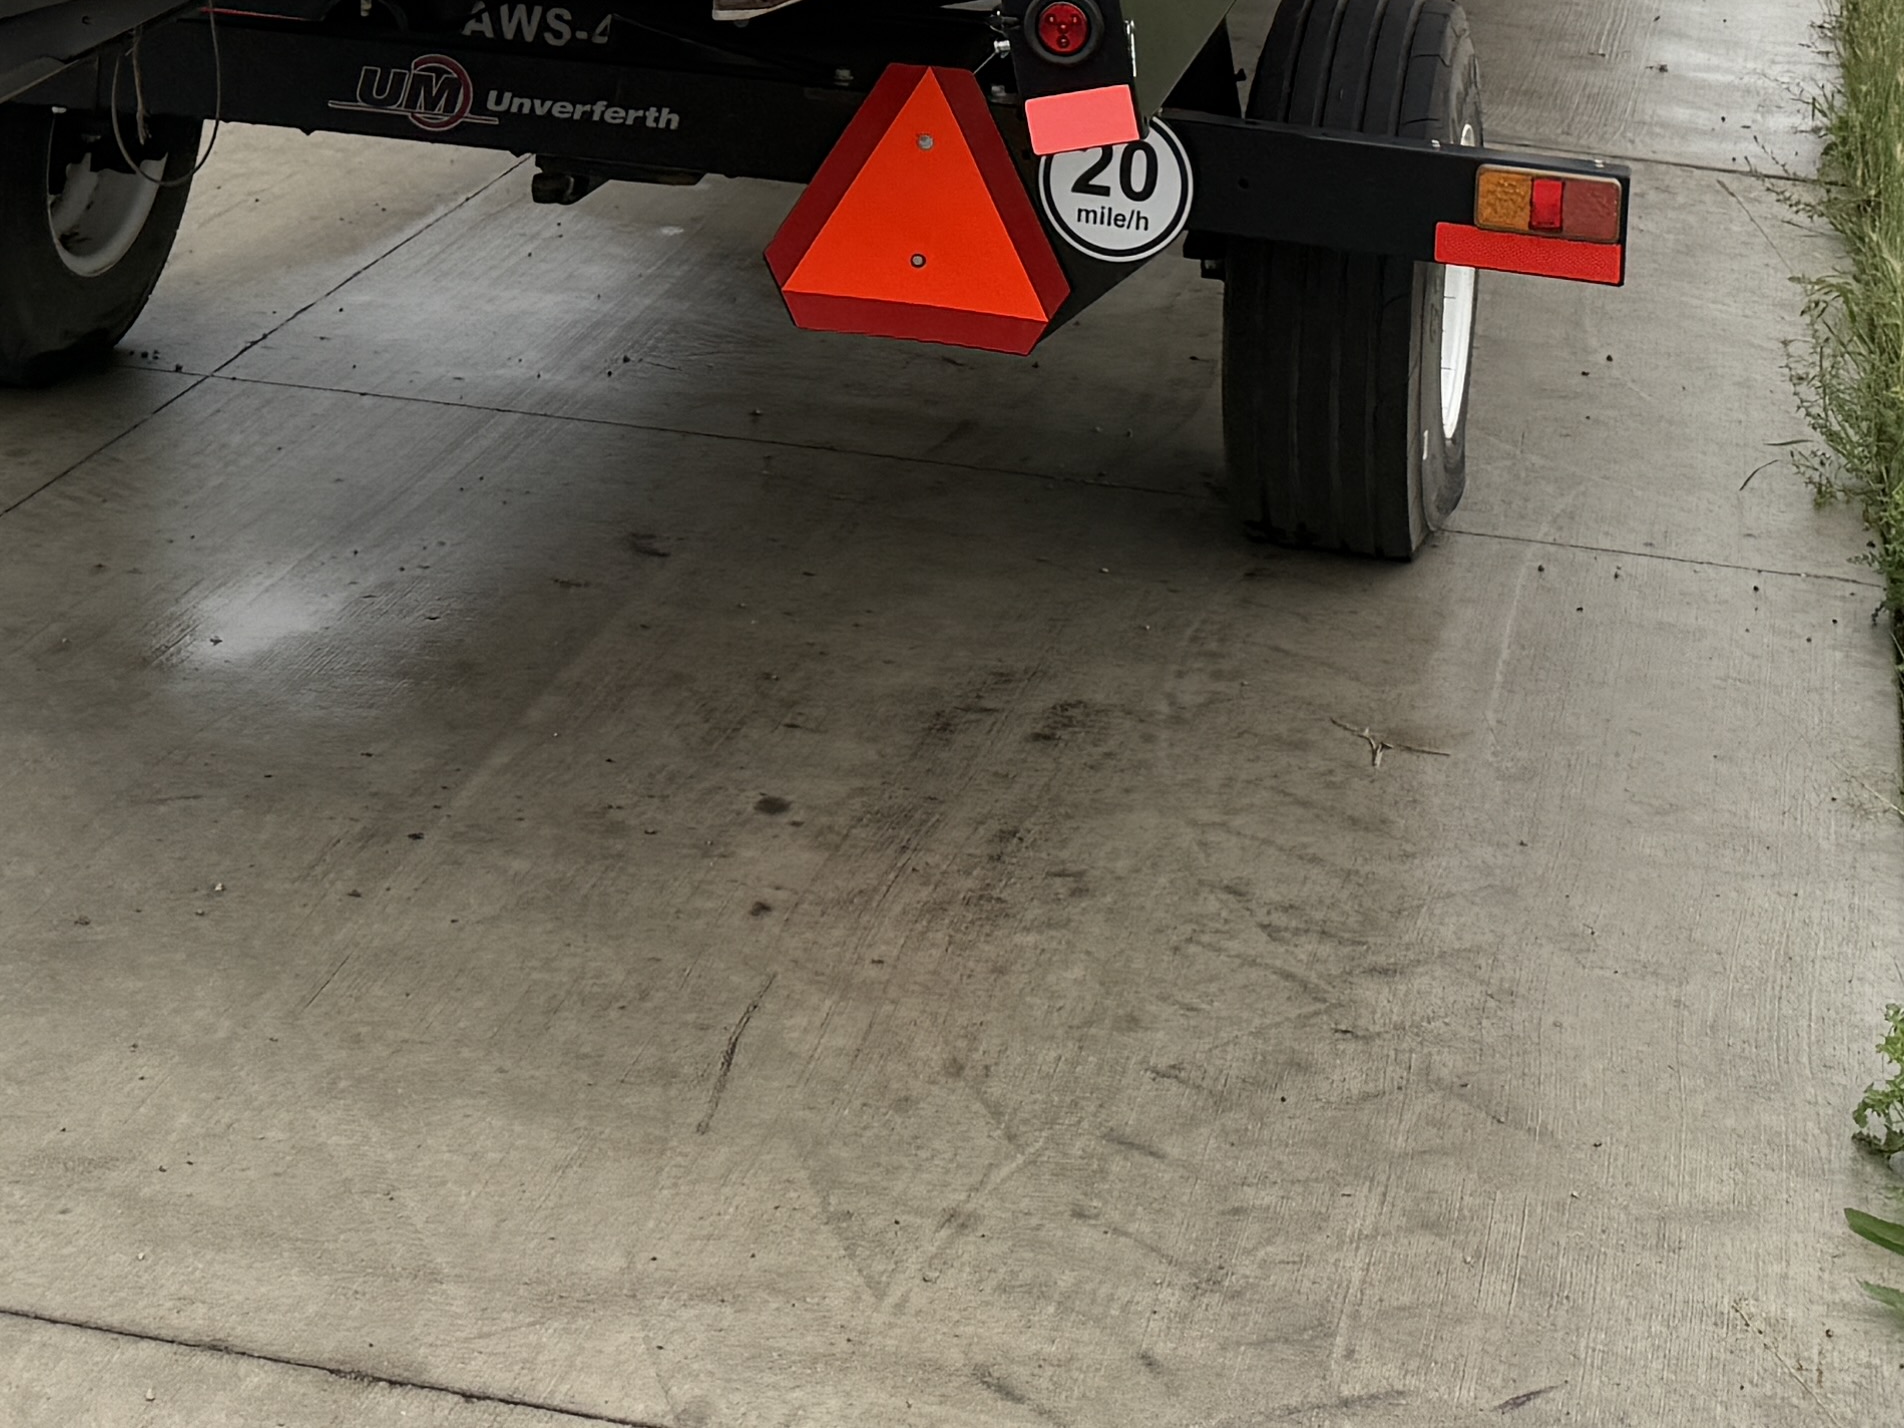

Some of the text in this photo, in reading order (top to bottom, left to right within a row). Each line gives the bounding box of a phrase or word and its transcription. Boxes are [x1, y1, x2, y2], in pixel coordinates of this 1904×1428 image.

[356, 66, 681, 131] UM Unverferth
[1071, 141, 1158, 202] 20
[1077, 206, 1149, 231] mile/h
